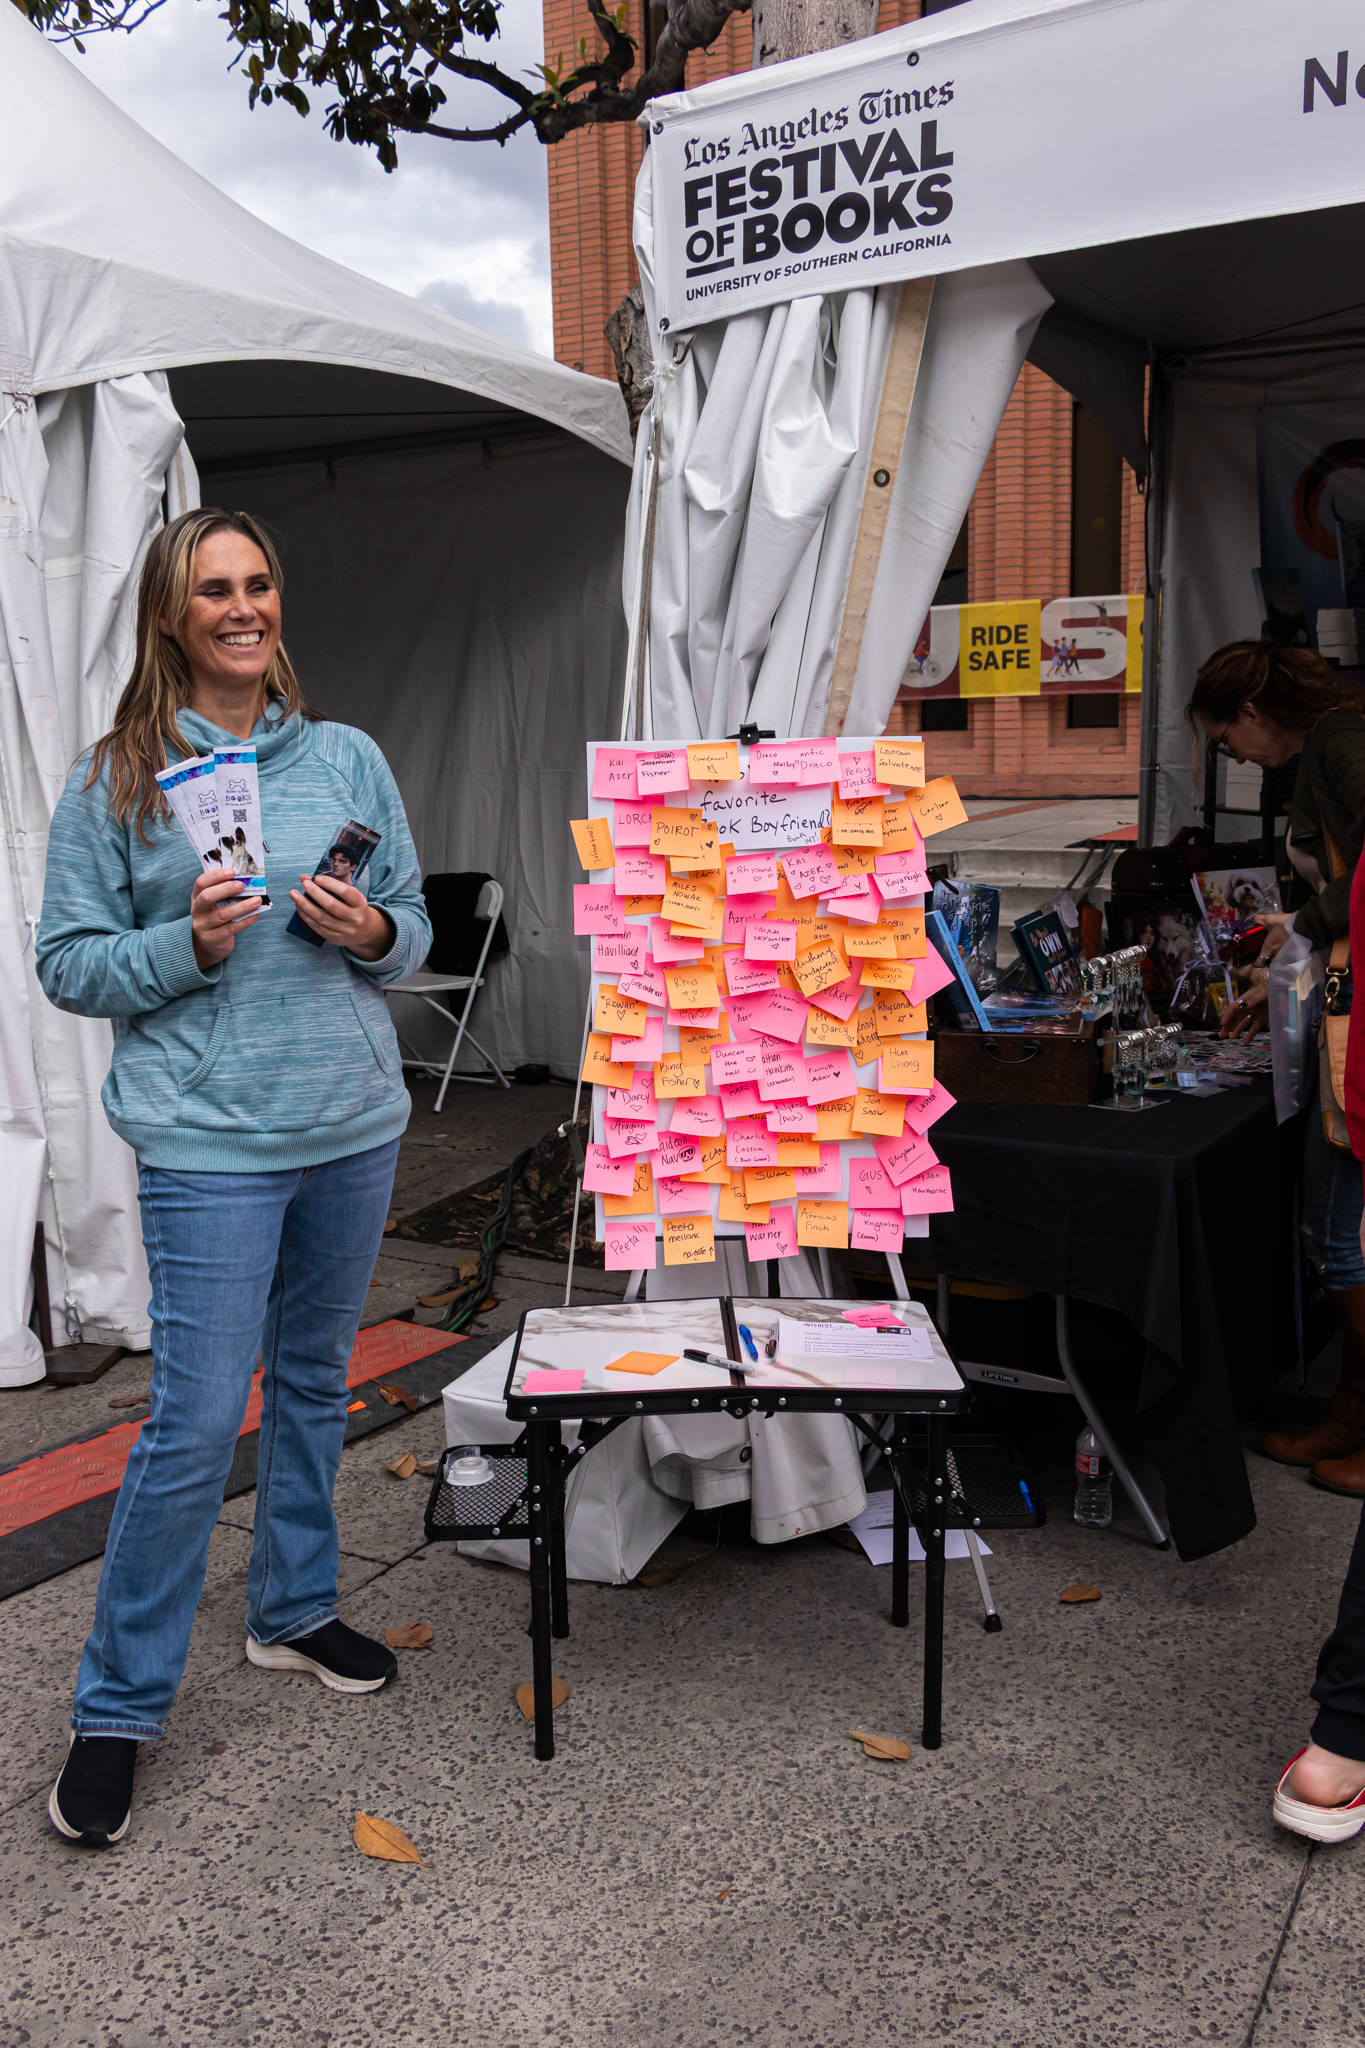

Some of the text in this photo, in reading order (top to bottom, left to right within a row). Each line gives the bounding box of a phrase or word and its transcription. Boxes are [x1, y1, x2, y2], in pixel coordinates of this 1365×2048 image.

[684, 79, 955, 171] Los Angeles Times
[684, 119, 954, 229] FESTIVAL
[686, 173, 954, 265] OF BOOKS
[686, 233, 952, 302] UNIVERSITY OF SOUTHERN CALIFORNIA
[971, 624, 1029, 647] RIDE
[968, 649, 1031, 672] SAFE
[800, 749, 825, 758] anfic
[609, 759, 624, 768] Kai
[801, 761, 833, 770] Draco
[843, 777, 877, 789] Jackso
[700, 790, 787, 812] favorite
[656, 821, 700, 838] POIROT
[786, 858, 808, 869] KAI
[671, 882, 699, 893] MILES
[1039, 931, 1063, 957] OWN
[605, 998, 636, 1010] Rowan
[821, 1023, 851, 1038] Darcy
[761, 1053, 782, 1065] athan
[890, 1059, 920, 1073] Cheng
[620, 1090, 651, 1106] Darcy
[864, 1094, 882, 1105] Jon
[860, 1169, 883, 1182] GUS
[984, 1371, 1016, 1383] LIFETIME
